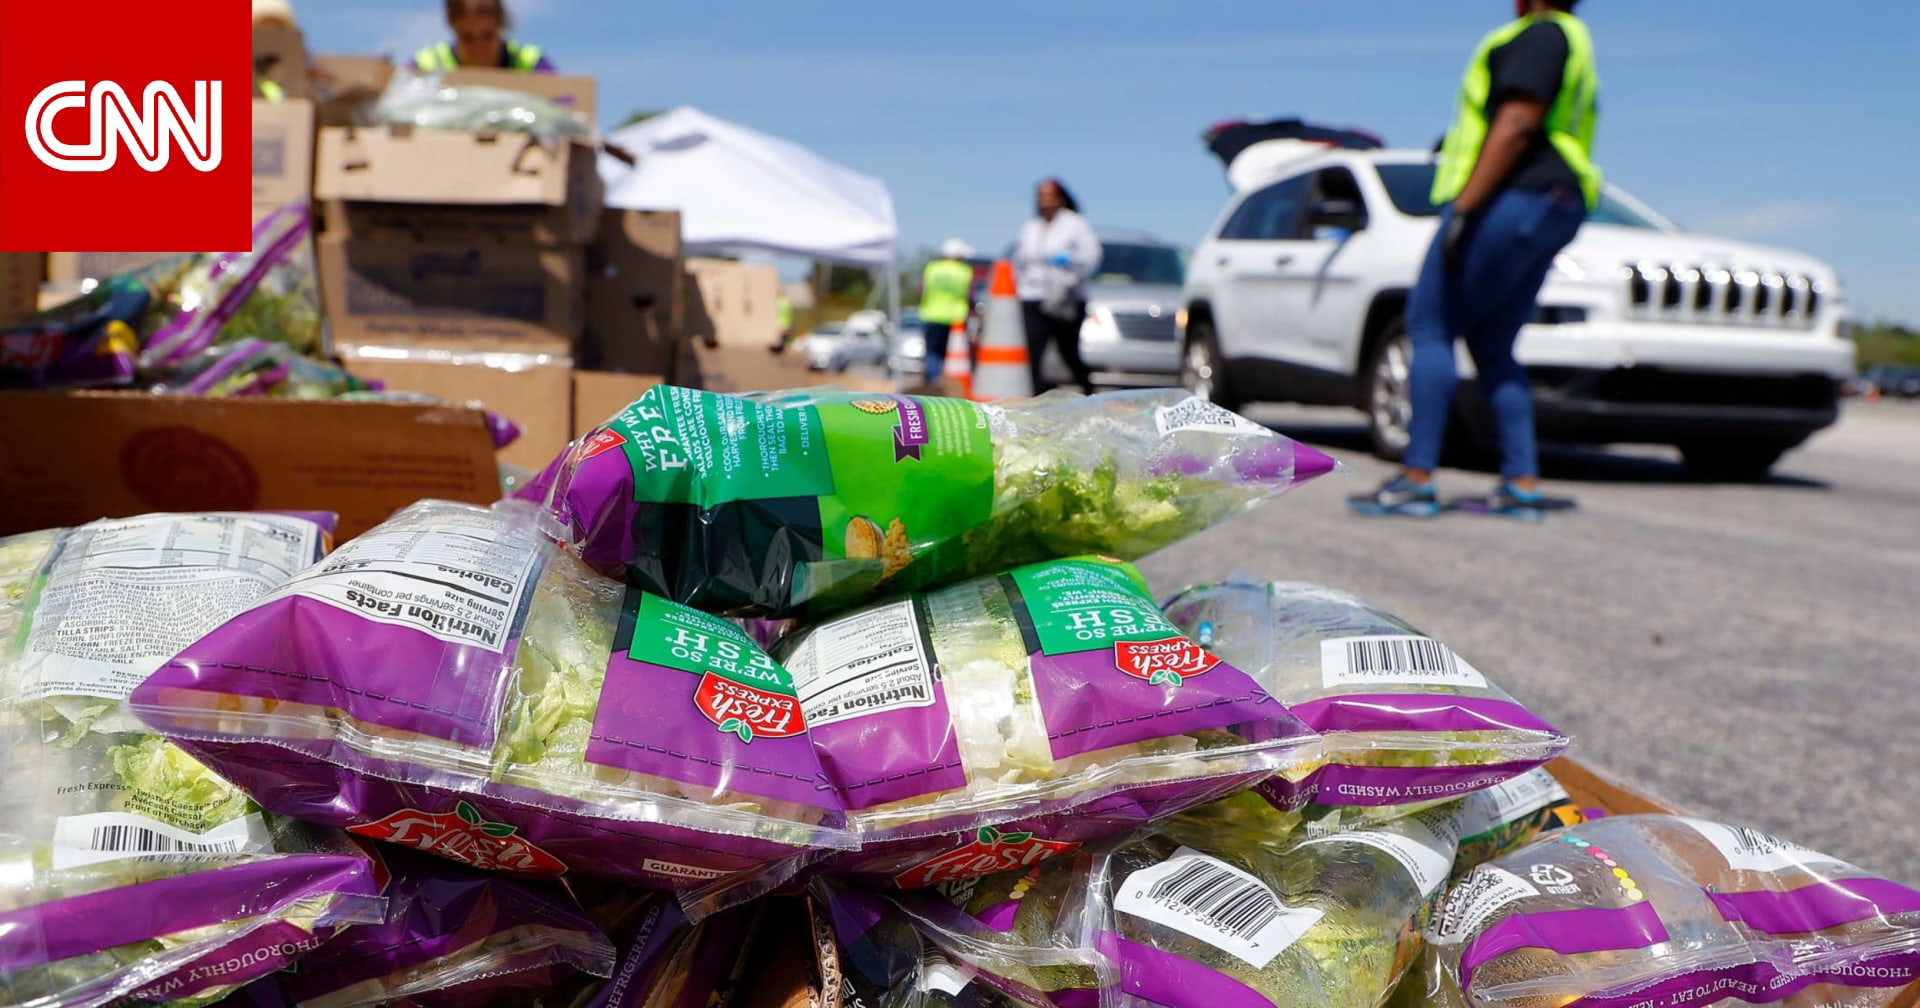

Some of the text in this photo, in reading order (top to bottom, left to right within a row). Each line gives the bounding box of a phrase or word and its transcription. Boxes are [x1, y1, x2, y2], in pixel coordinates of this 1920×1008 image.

[686, 418, 698, 438] ARE
[766, 424, 776, 445] SEAL
[909, 410, 923, 439] FRESH
[631, 429, 657, 472] WHY
[777, 436, 787, 454] BAG
[722, 447, 733, 472] COOL
[767, 447, 779, 471] THEN
[437, 566, 514, 595] Calories
[346, 589, 497, 645] Nutrition Facts
[348, 579, 501, 630] About 2.5 servings per container
[445, 590, 505, 621] Serving size
[1076, 630, 1106, 641] SO
[671, 646, 782, 685] WE'RE SO
[847, 645, 914, 670] Calories
[1132, 648, 1209, 676] Fresh
[843, 682, 879, 699] servings
[880, 678, 896, 690] 2.5
[897, 673, 922, 686] About
[714, 681, 794, 711] EXPRESS
[844, 684, 925, 711] Nutrition
[711, 693, 792, 733] Fresh
[57, 783, 85, 795] Fresh
[1262, 783, 1278, 799] TO
[1337, 783, 1400, 798] WASHED
[1403, 774, 1508, 797] THOROUGHLY
[124, 801, 206, 829] Proof of Purchase
[131, 794, 202, 820] Avocado Caesar
[384, 818, 536, 868] Fresh
[922, 842, 1054, 887] Fresh
[1135, 890, 1143, 899] 0
[1475, 886, 1514, 912] Delicious
[1500, 887, 1528, 901] More!
[1545, 883, 1582, 896] OTHER
[190, 936, 324, 983] THOROUGHLY
[1671, 989, 1693, 1005] EAT
[1695, 983, 1711, 998] TO
[1711, 978, 1757, 995] READY
